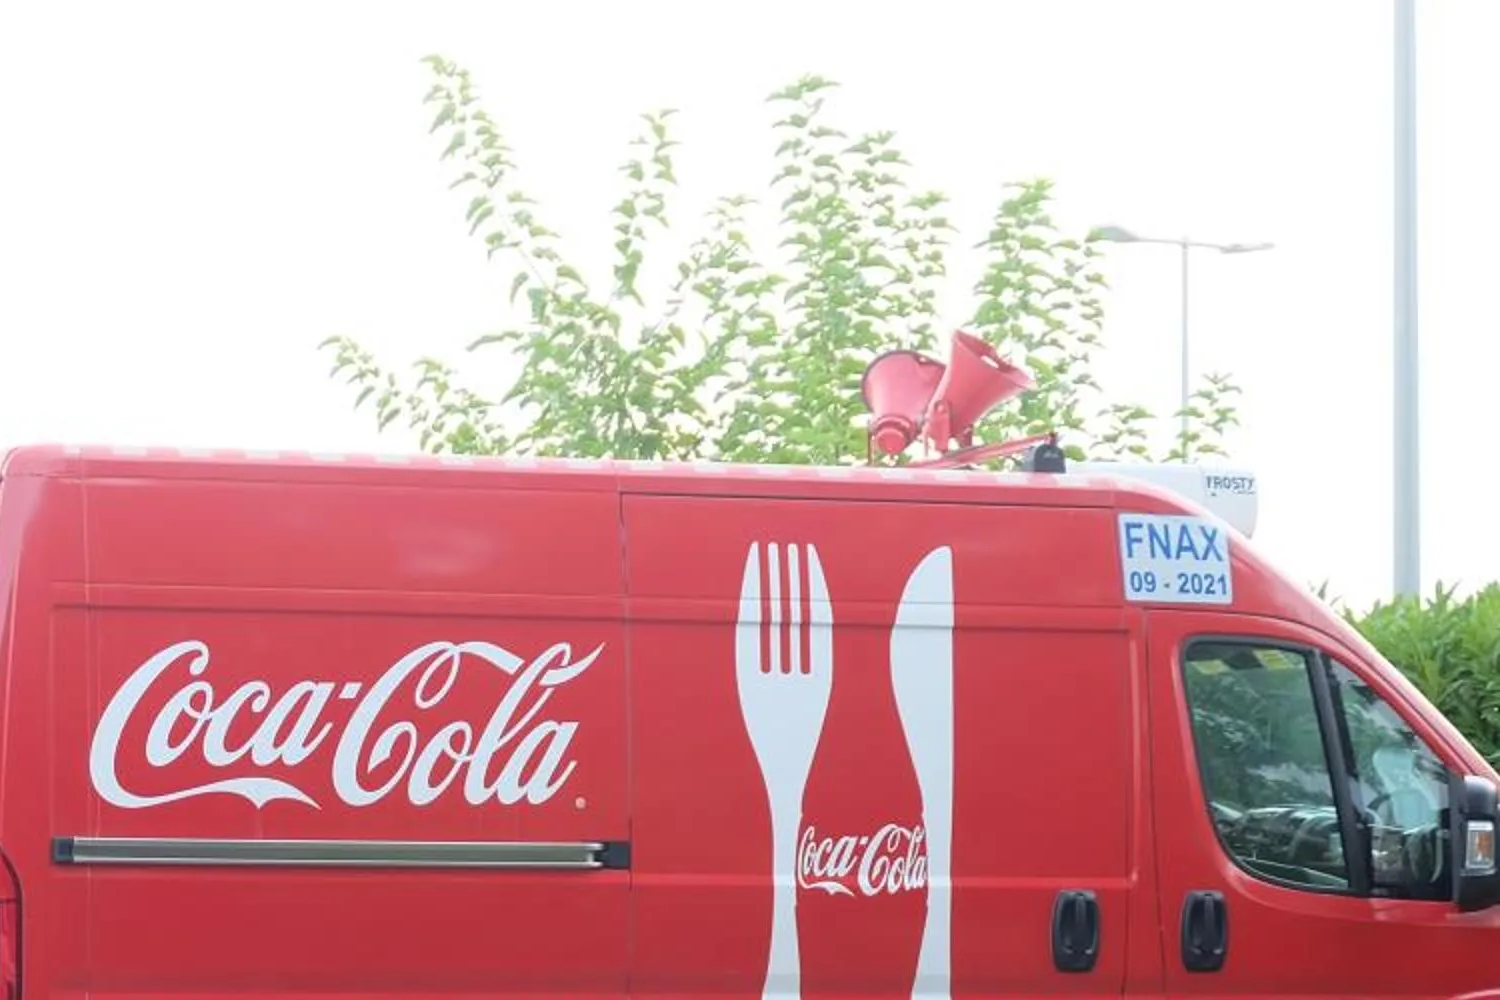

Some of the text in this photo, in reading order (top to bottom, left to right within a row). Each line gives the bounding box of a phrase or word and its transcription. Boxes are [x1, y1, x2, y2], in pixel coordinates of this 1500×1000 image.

[1206, 475, 1255, 490] FROSTY
[1124, 522, 1224, 562] FNAX
[1130, 570, 1157, 593] 09
[1177, 572, 1227, 595] 2021
[89, 639, 606, 810] Coca-Cola
[797, 823, 927, 897] Coca-Cola
